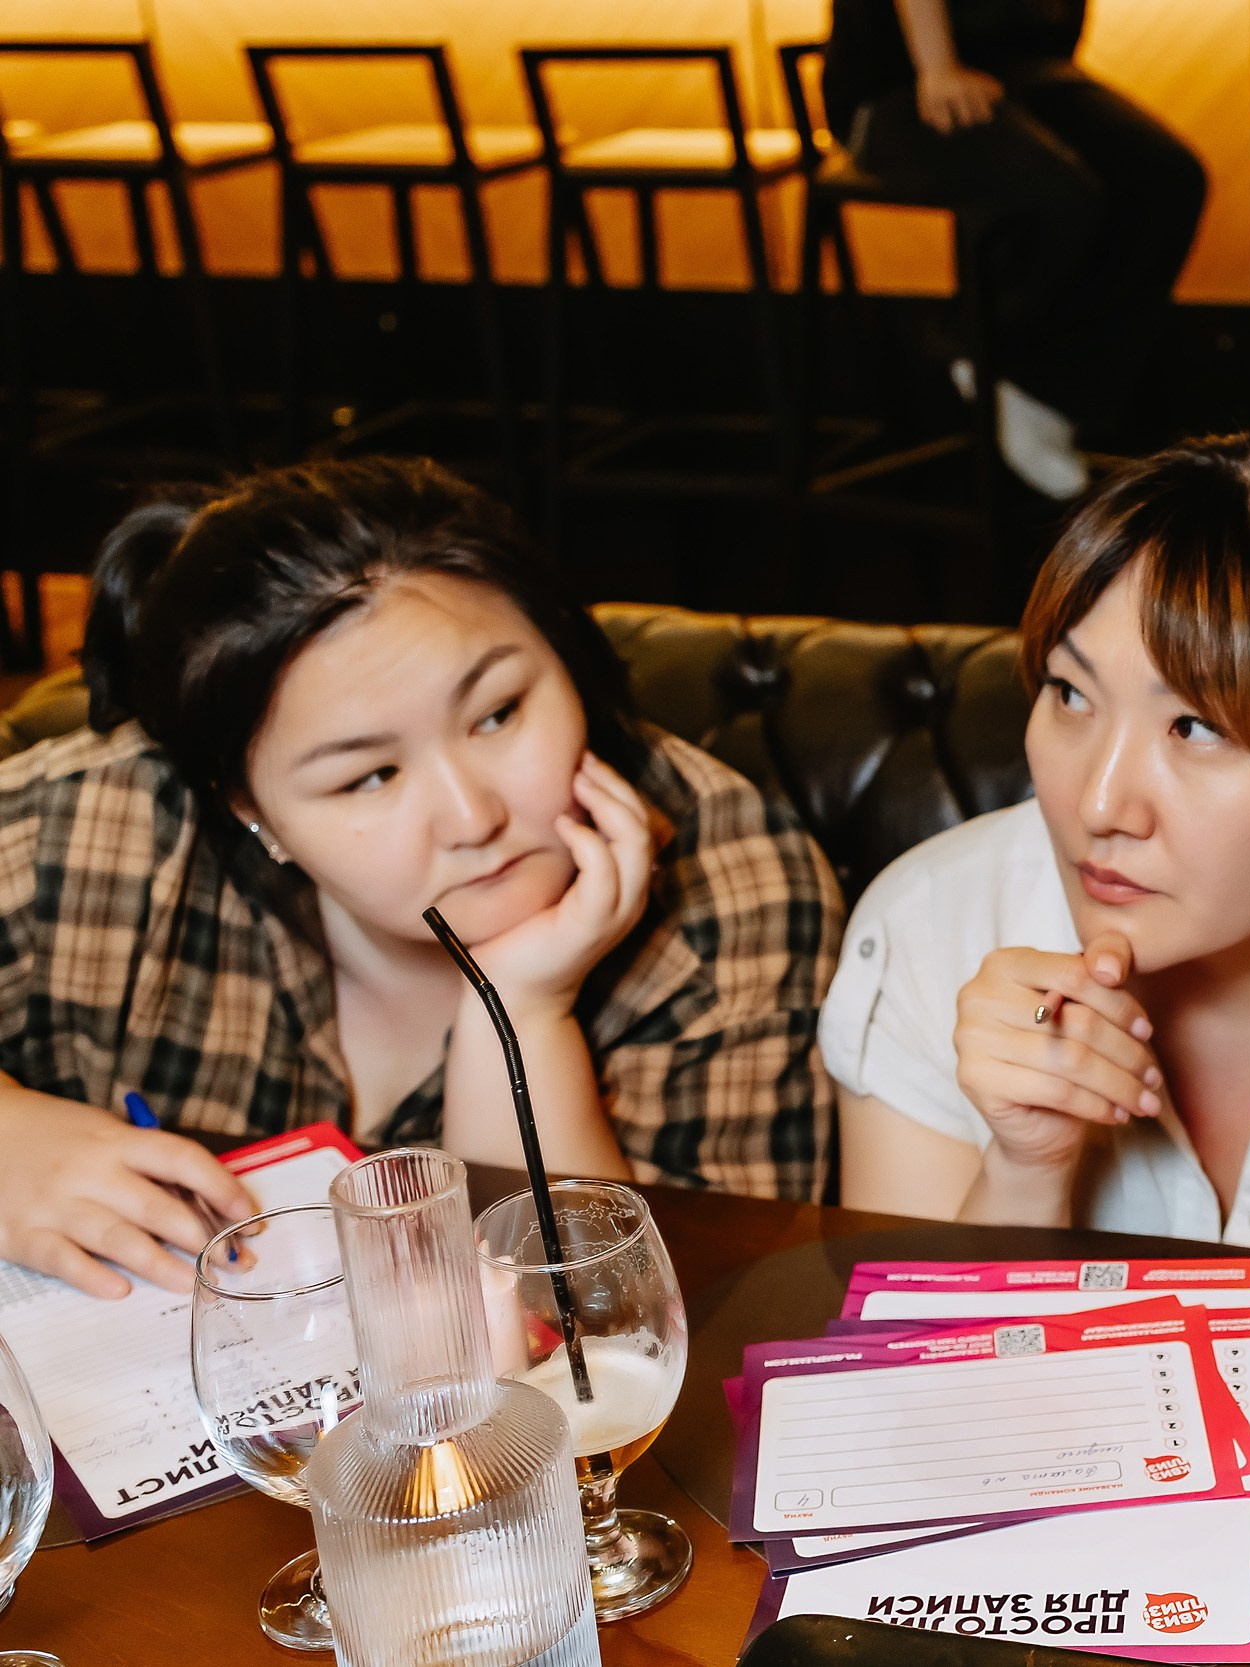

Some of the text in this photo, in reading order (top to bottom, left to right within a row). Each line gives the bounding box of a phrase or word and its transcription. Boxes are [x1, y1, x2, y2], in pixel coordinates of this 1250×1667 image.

[117, 1454, 219, 1506] ЛИСТ
[1029, 1483, 1123, 1497] НАЗВАНИЕ КОМАНДЫ
[867, 1589, 1130, 1616] ДЛЯ ЗАПИСИ
[954, 1614, 1126, 1636] ПРОСТО
